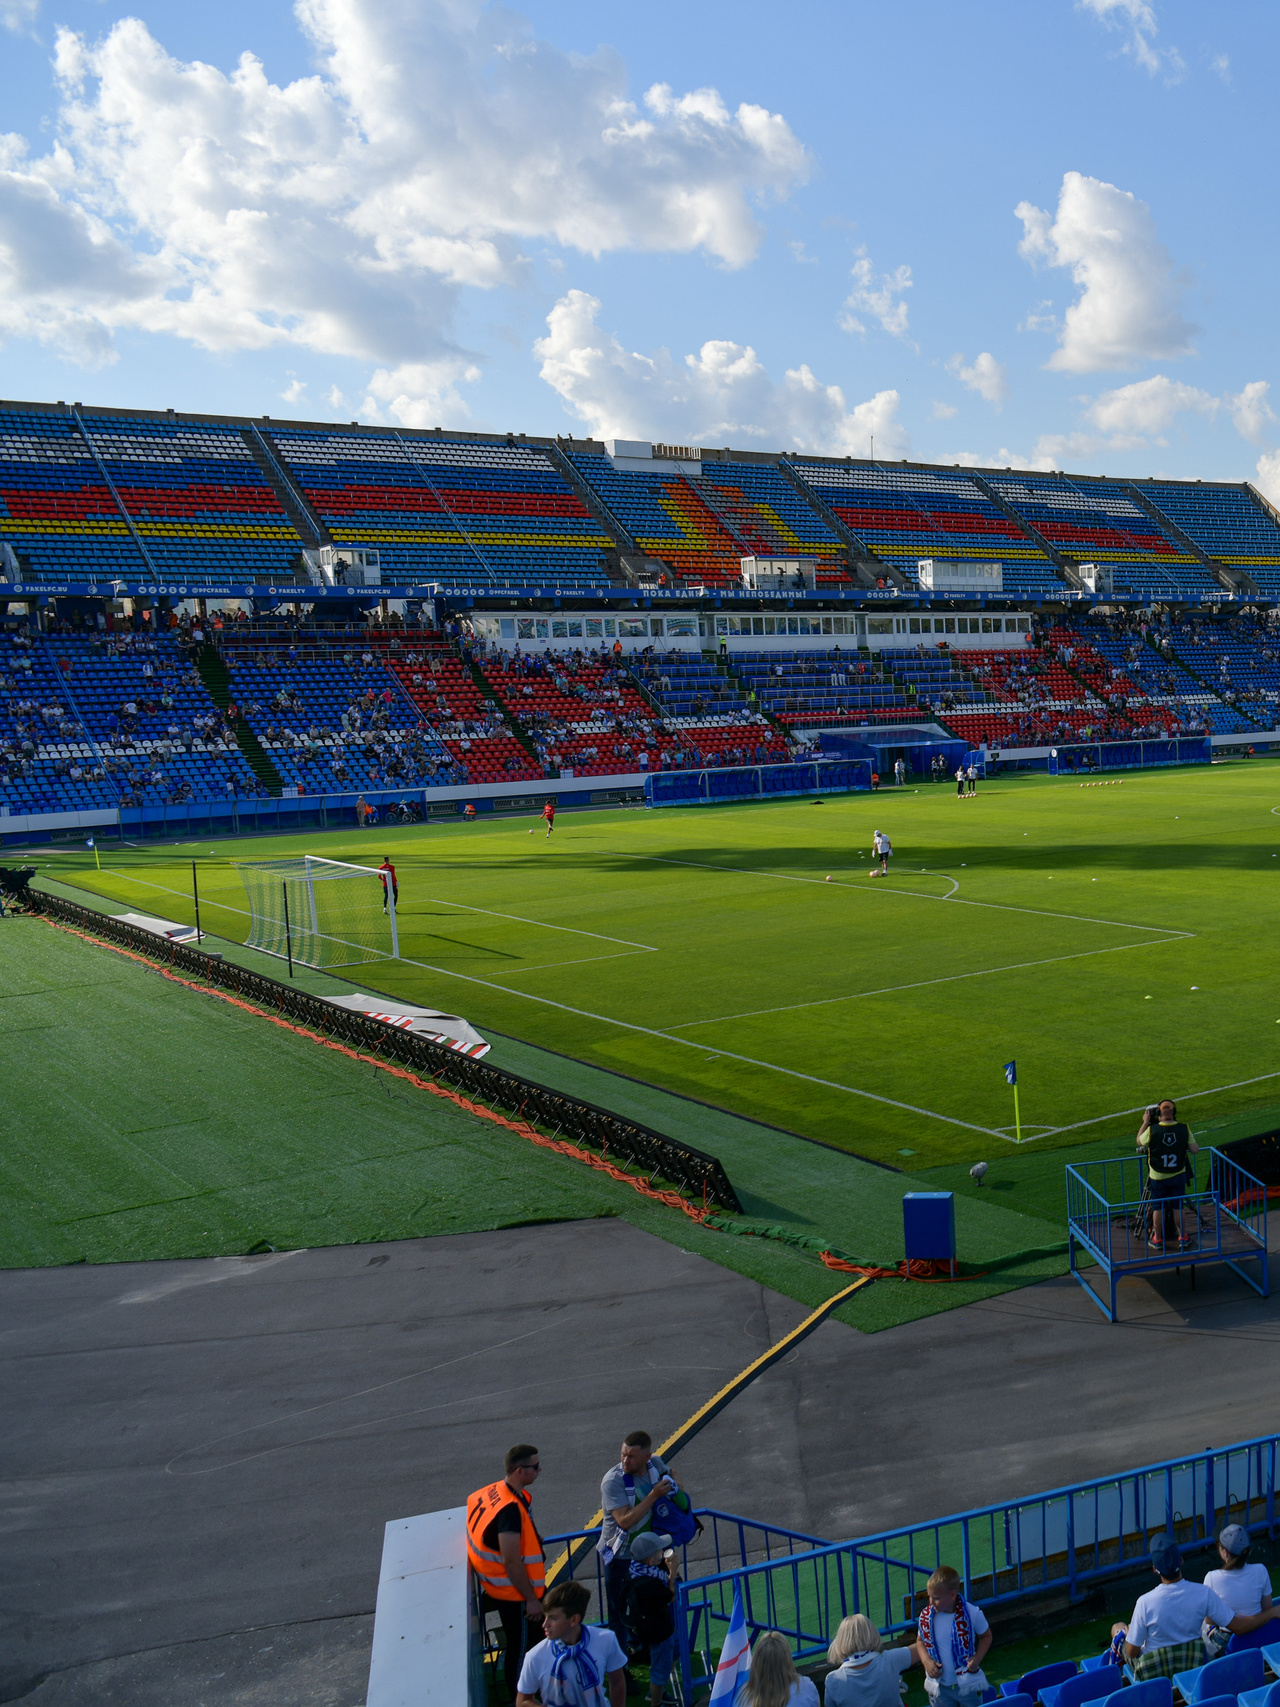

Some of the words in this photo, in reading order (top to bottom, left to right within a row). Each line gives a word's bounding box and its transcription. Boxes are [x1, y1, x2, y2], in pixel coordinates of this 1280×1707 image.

[643, 590, 671, 598] ПОКА
[675, 590, 709, 599] ЕДИН
[720, 590, 735, 598] МЫ
[739, 590, 806, 599] НЕПОБЕДИМЫ!
[1161, 1154, 1178, 1168] 12
[468, 1496, 487, 1534] 11
